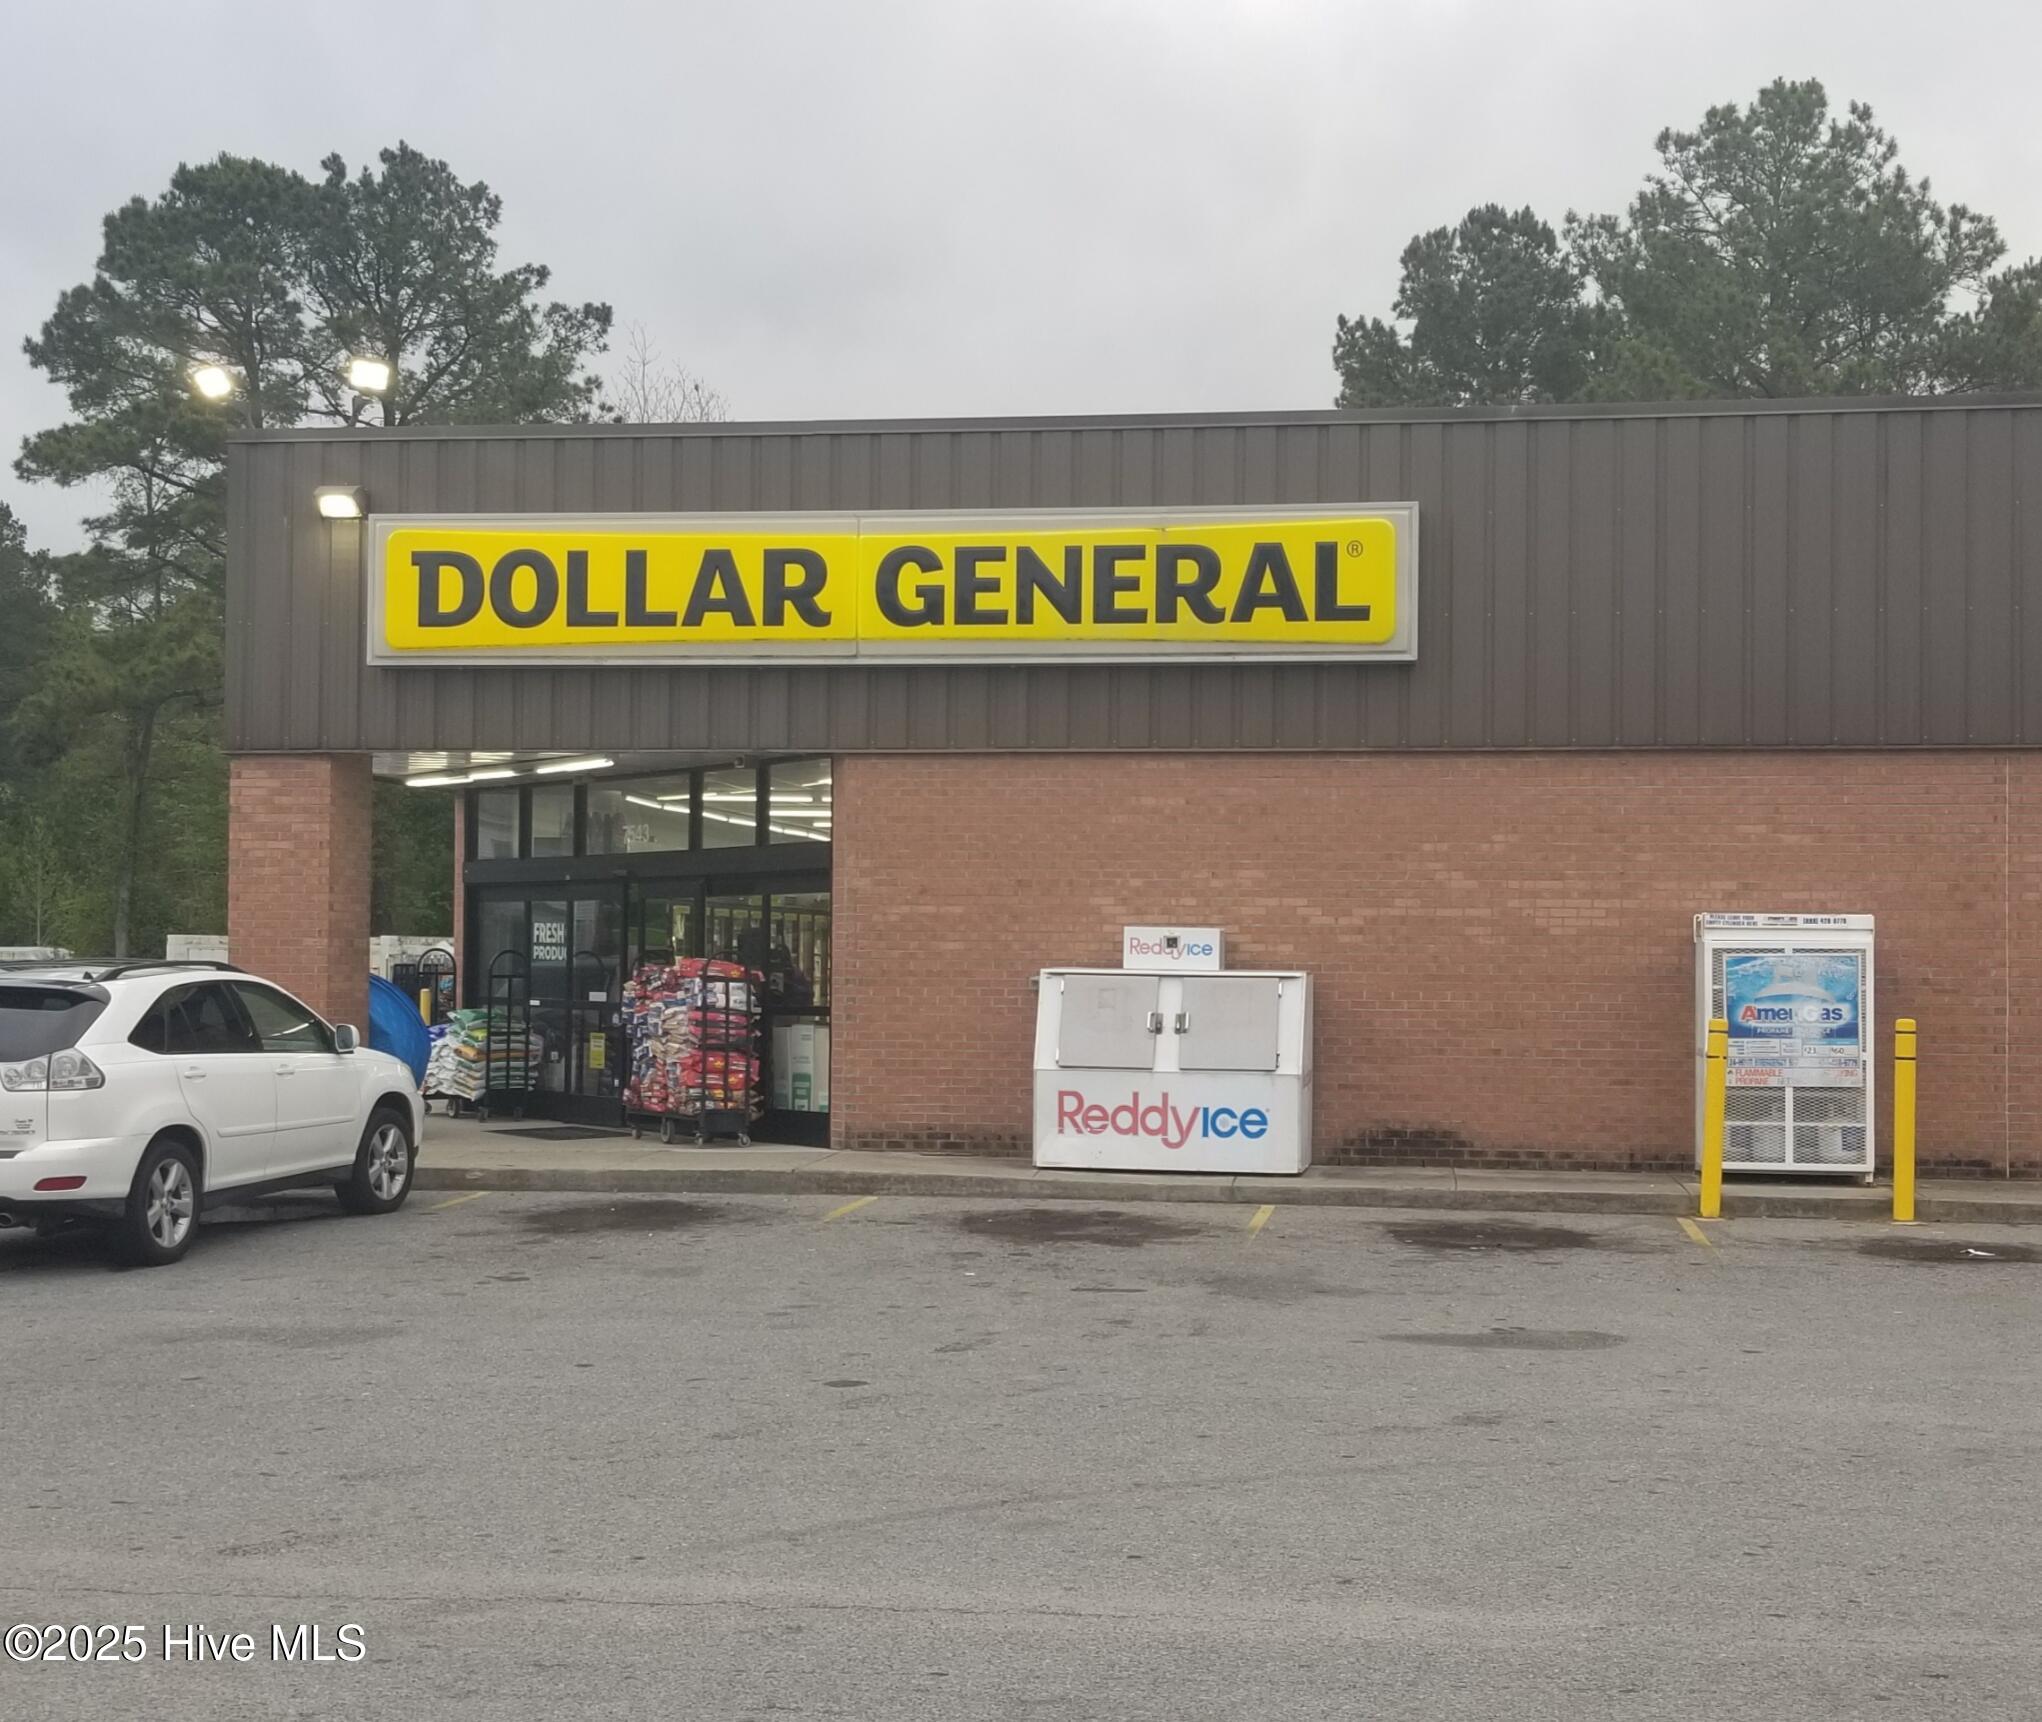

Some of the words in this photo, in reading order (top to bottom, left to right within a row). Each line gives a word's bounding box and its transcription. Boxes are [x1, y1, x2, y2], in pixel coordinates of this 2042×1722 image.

[411, 547, 832, 628] DOLLAR
[533, 922, 565, 943] FRESH
[1741, 1004, 1843, 1020] AmeGas
